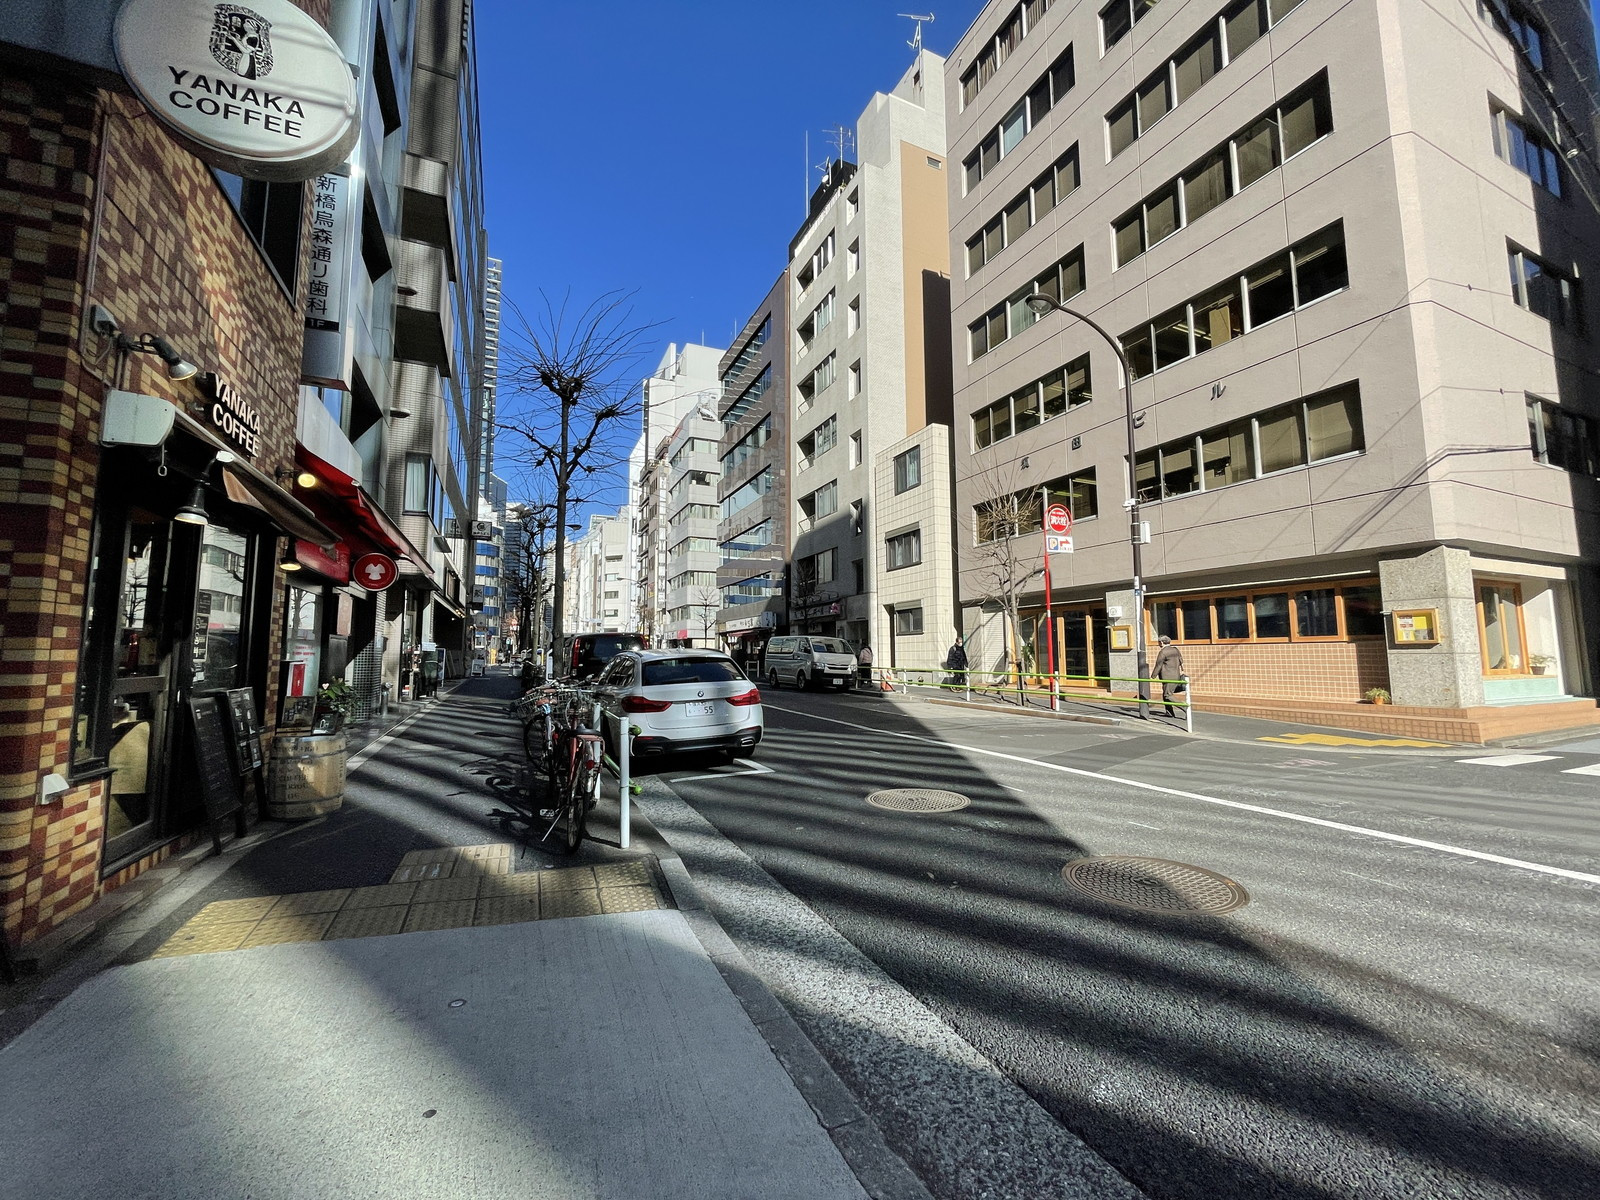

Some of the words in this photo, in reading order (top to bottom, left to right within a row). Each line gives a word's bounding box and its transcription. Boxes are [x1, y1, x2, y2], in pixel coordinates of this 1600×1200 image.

[168, 65, 305, 119] YANAKA
[169, 90, 302, 139] COFFEE
[307, 174, 338, 316] 新橋烏森通り歯科
[310, 318, 325, 328] 1F
[213, 403, 260, 458] COFFEE
[214, 373, 261, 435] YANAKA
